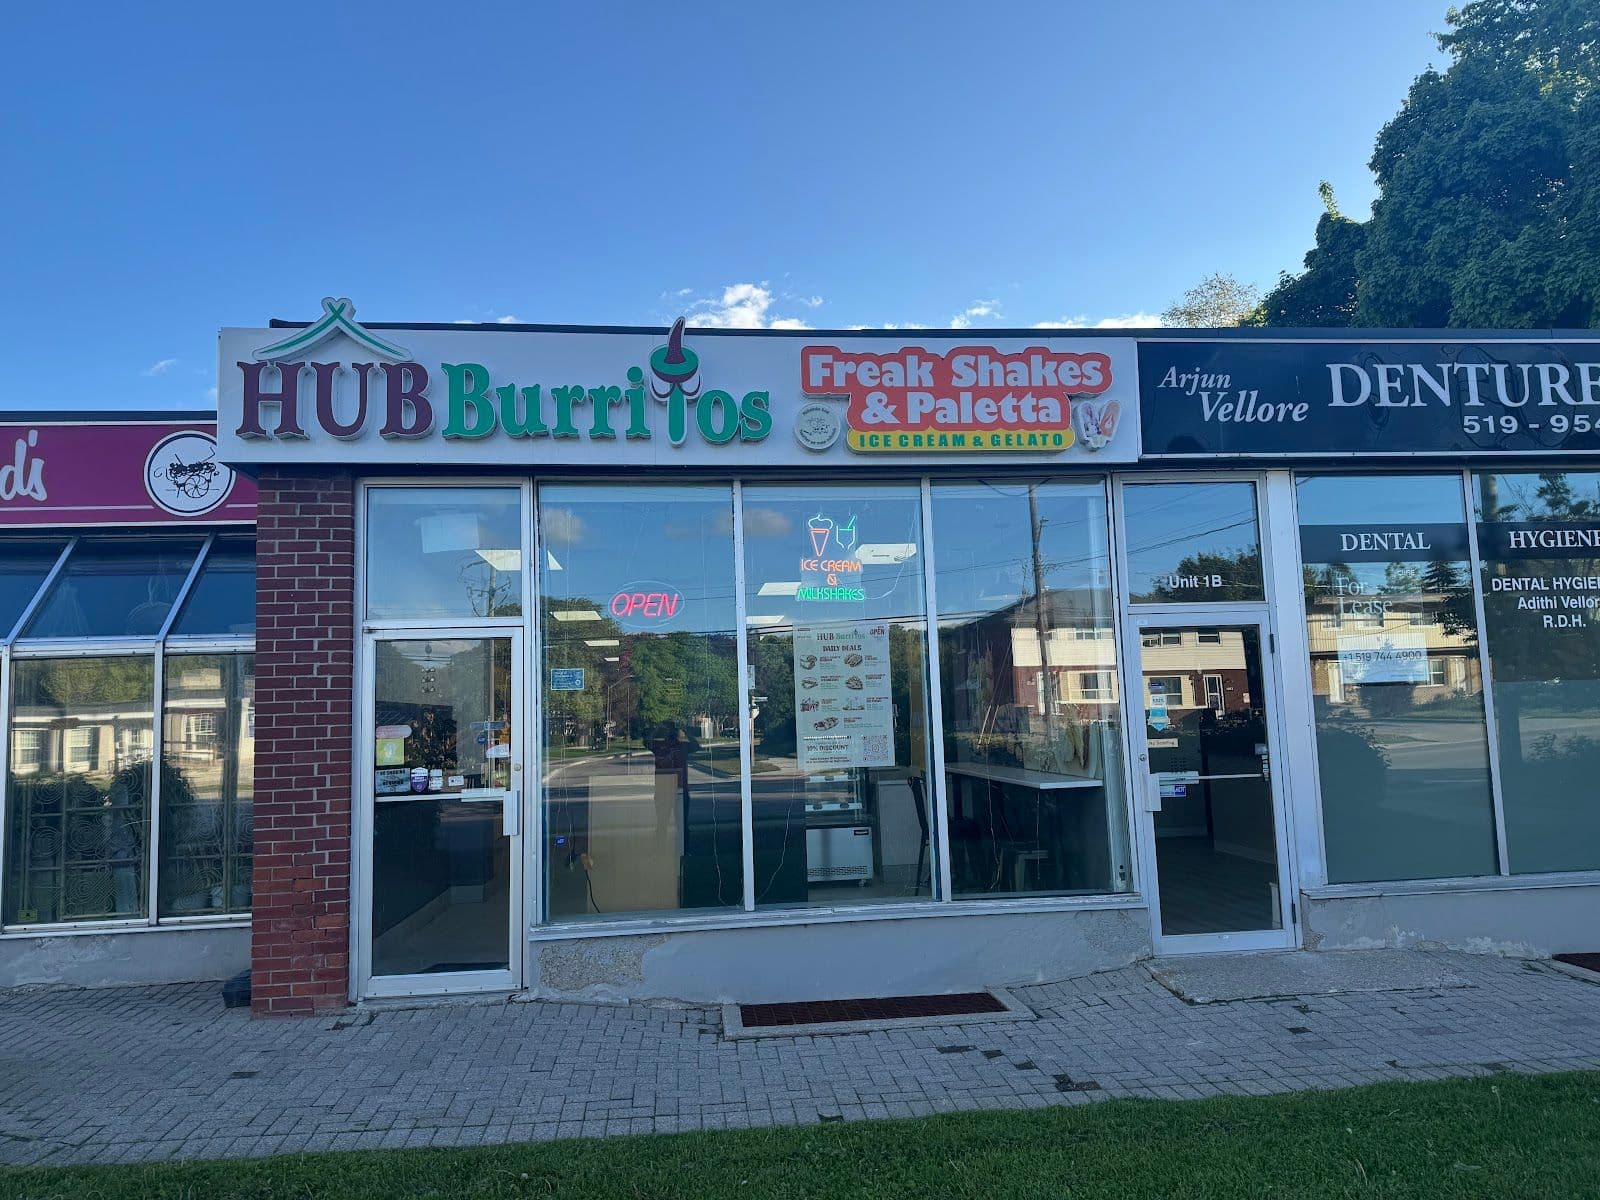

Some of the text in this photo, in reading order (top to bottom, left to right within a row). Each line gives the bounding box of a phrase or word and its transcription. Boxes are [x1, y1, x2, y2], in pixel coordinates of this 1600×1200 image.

[808, 353, 1103, 388] Freak Shakes
[1157, 365, 1231, 395] Arjun
[235, 317, 773, 446] HUB Burritos
[1326, 362, 1600, 408] DENTURE
[860, 391, 1061, 425] & Paletta
[1199, 390, 1309, 422] Vellore
[1463, 415, 1518, 434] 519
[860, 433, 1063, 448] ICE CREAM & GELATO
[1341, 532, 1431, 551] DENTAL
[801, 559, 862, 573] ICE CREAM
[1169, 574, 1223, 589] Unit 1B
[1336, 577, 1369, 596] For
[1492, 576, 1600, 591] DENTAL HYGIE
[796, 586, 865, 601] MILKSHAKES
[1518, 596, 1557, 610] Adithi
[611, 593, 679, 618] OPEN
[1337, 596, 1393, 615] Lease
[1543, 614, 1587, 629] R.D.H.
[817, 632, 834, 641] HUB
[1355, 652, 1372, 662] 519
[1373, 651, 1392, 662] 744
[1395, 650, 1422, 660] 4900
